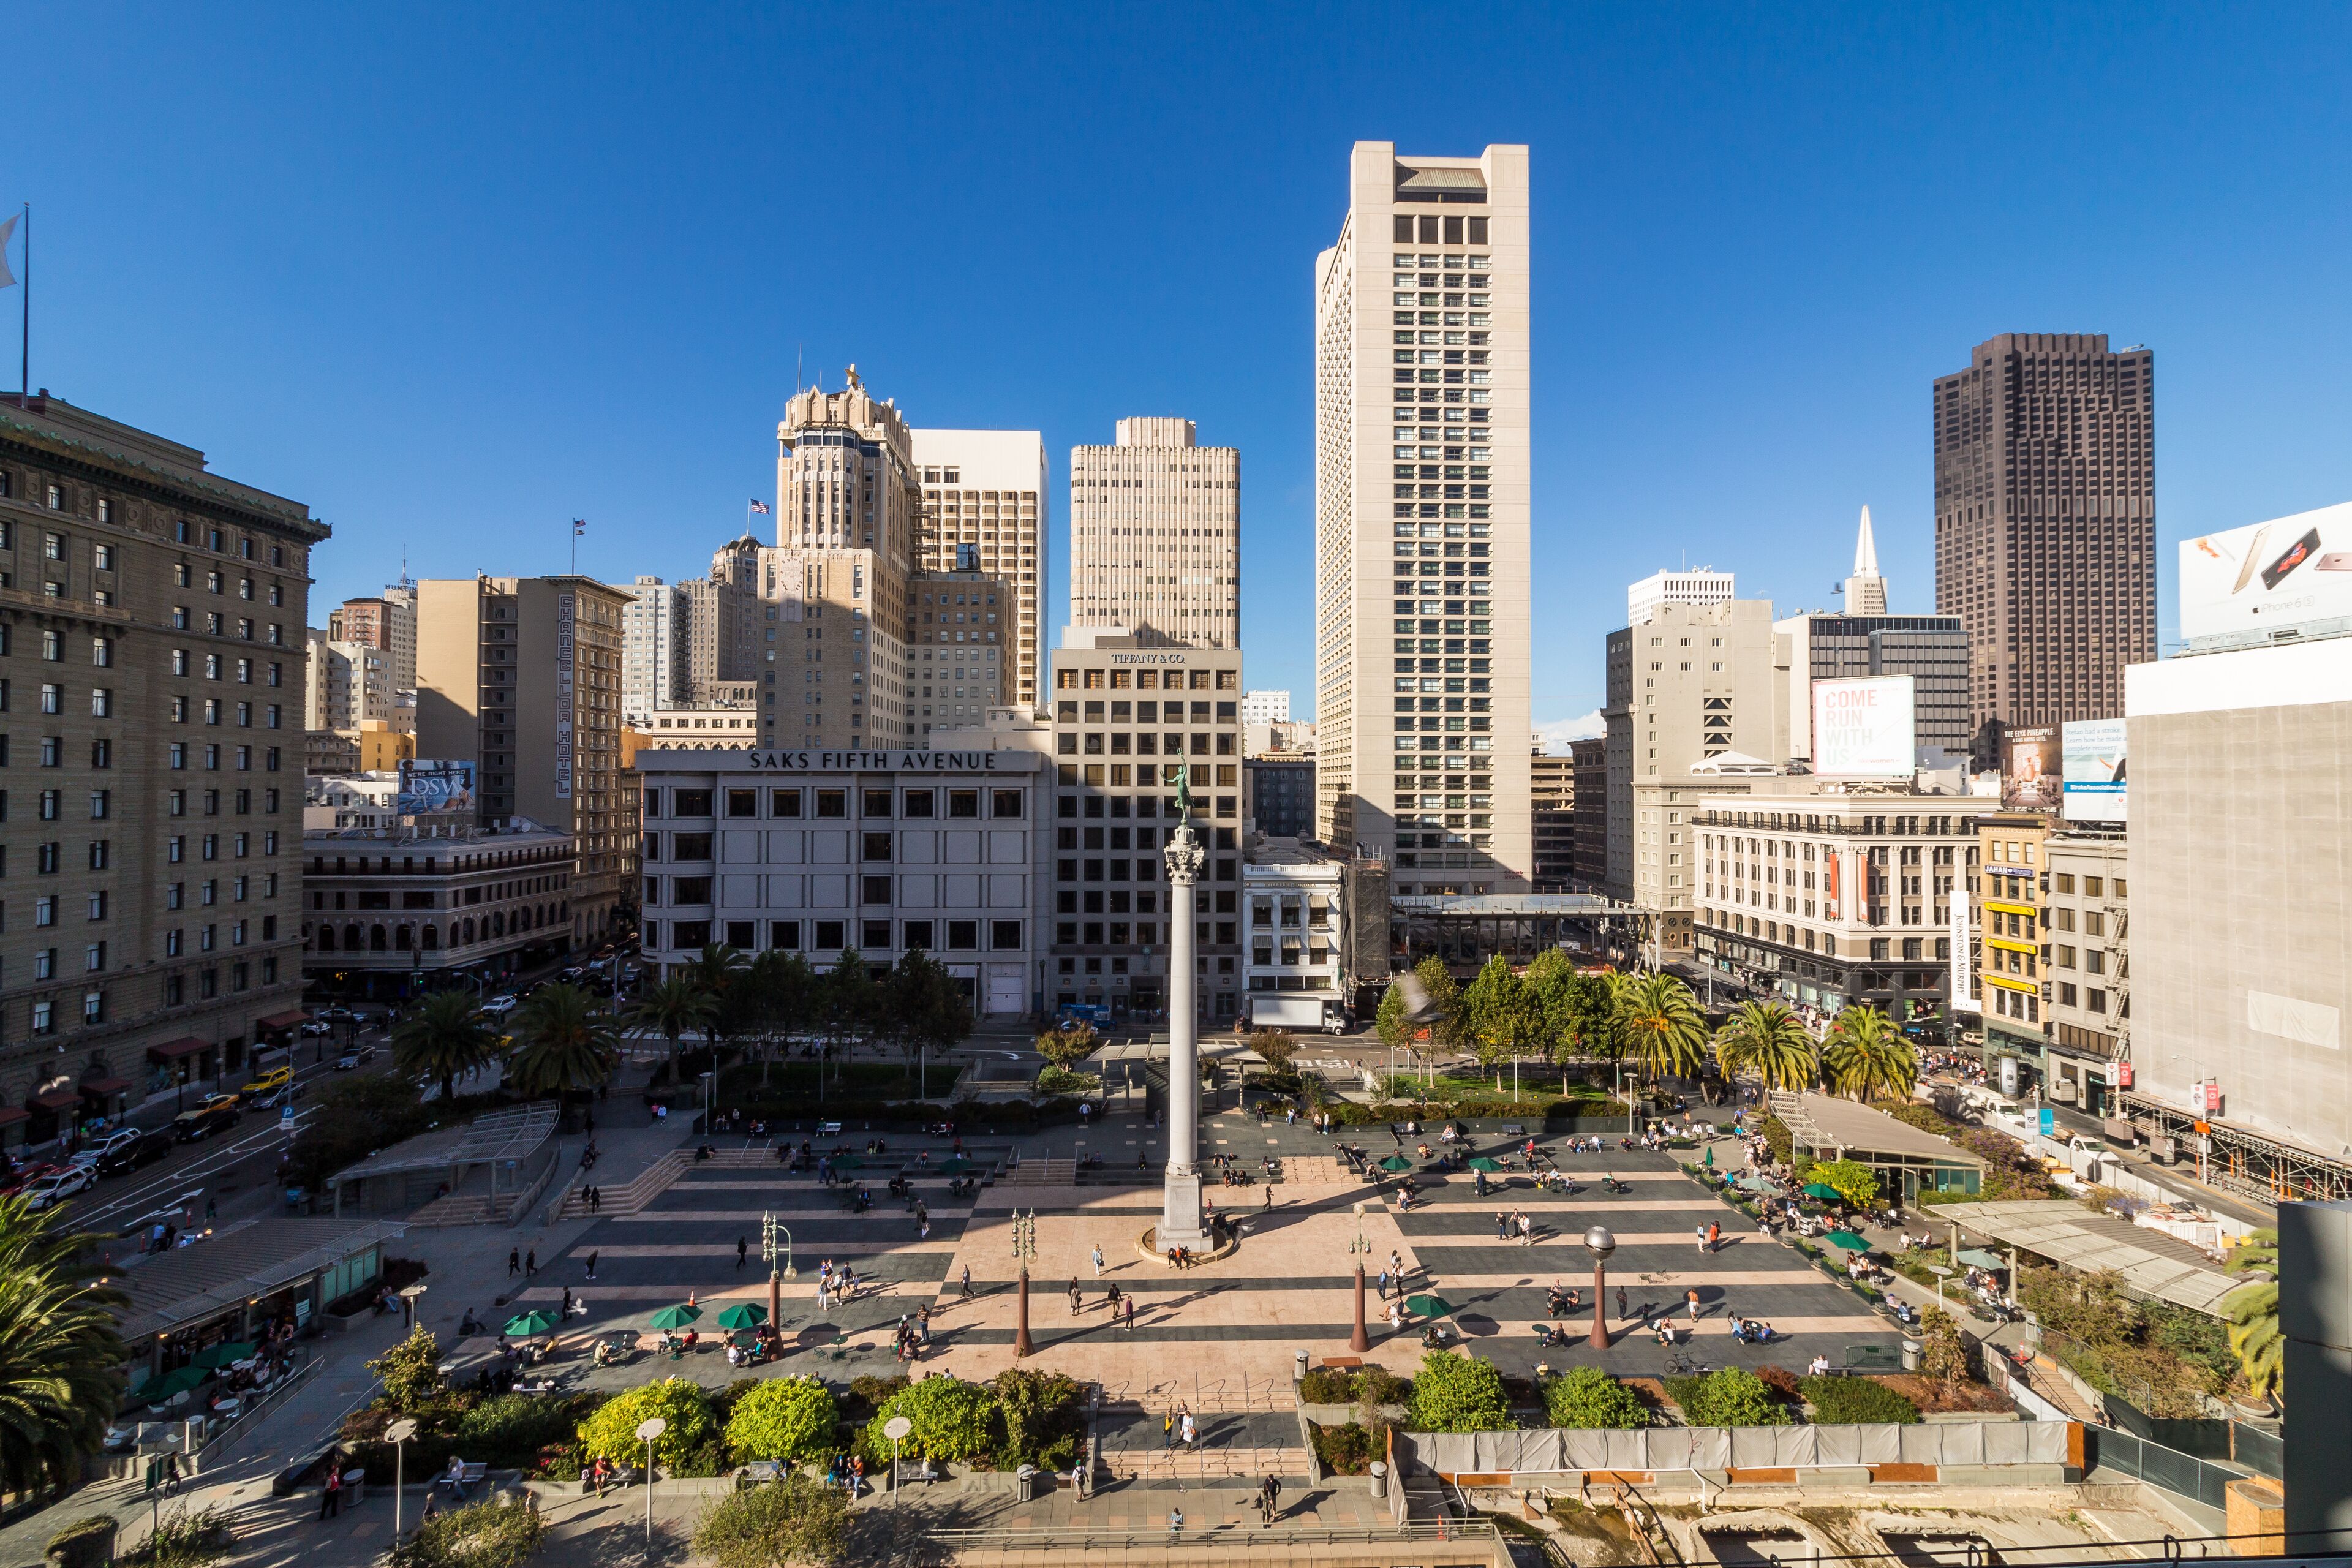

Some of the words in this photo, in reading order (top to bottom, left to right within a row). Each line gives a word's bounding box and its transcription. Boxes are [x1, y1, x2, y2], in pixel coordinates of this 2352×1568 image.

[2261, 601, 2293, 613] iPhone
[2294, 598, 2301, 608] 6
[1111, 654, 1158, 663] TIFFANY
[1159, 654, 1167, 663] &
[1826, 689, 1877, 708] COME
[1826, 709, 1863, 727] RUN
[1825, 729, 1872, 747] WITH
[2027, 728, 2056, 736] PINEAPPLE.
[750, 752, 809, 769] SAKS
[823, 752, 887, 769] FIFTH
[902, 752, 995, 769] AVENUE
[1826, 748, 1850, 766] US
[410, 778, 466, 796] DSW
[1954, 914, 1964, 953] JOHNSTON
[1956, 962, 1966, 995] MURPHY
[284, 1107, 292, 1117] P
